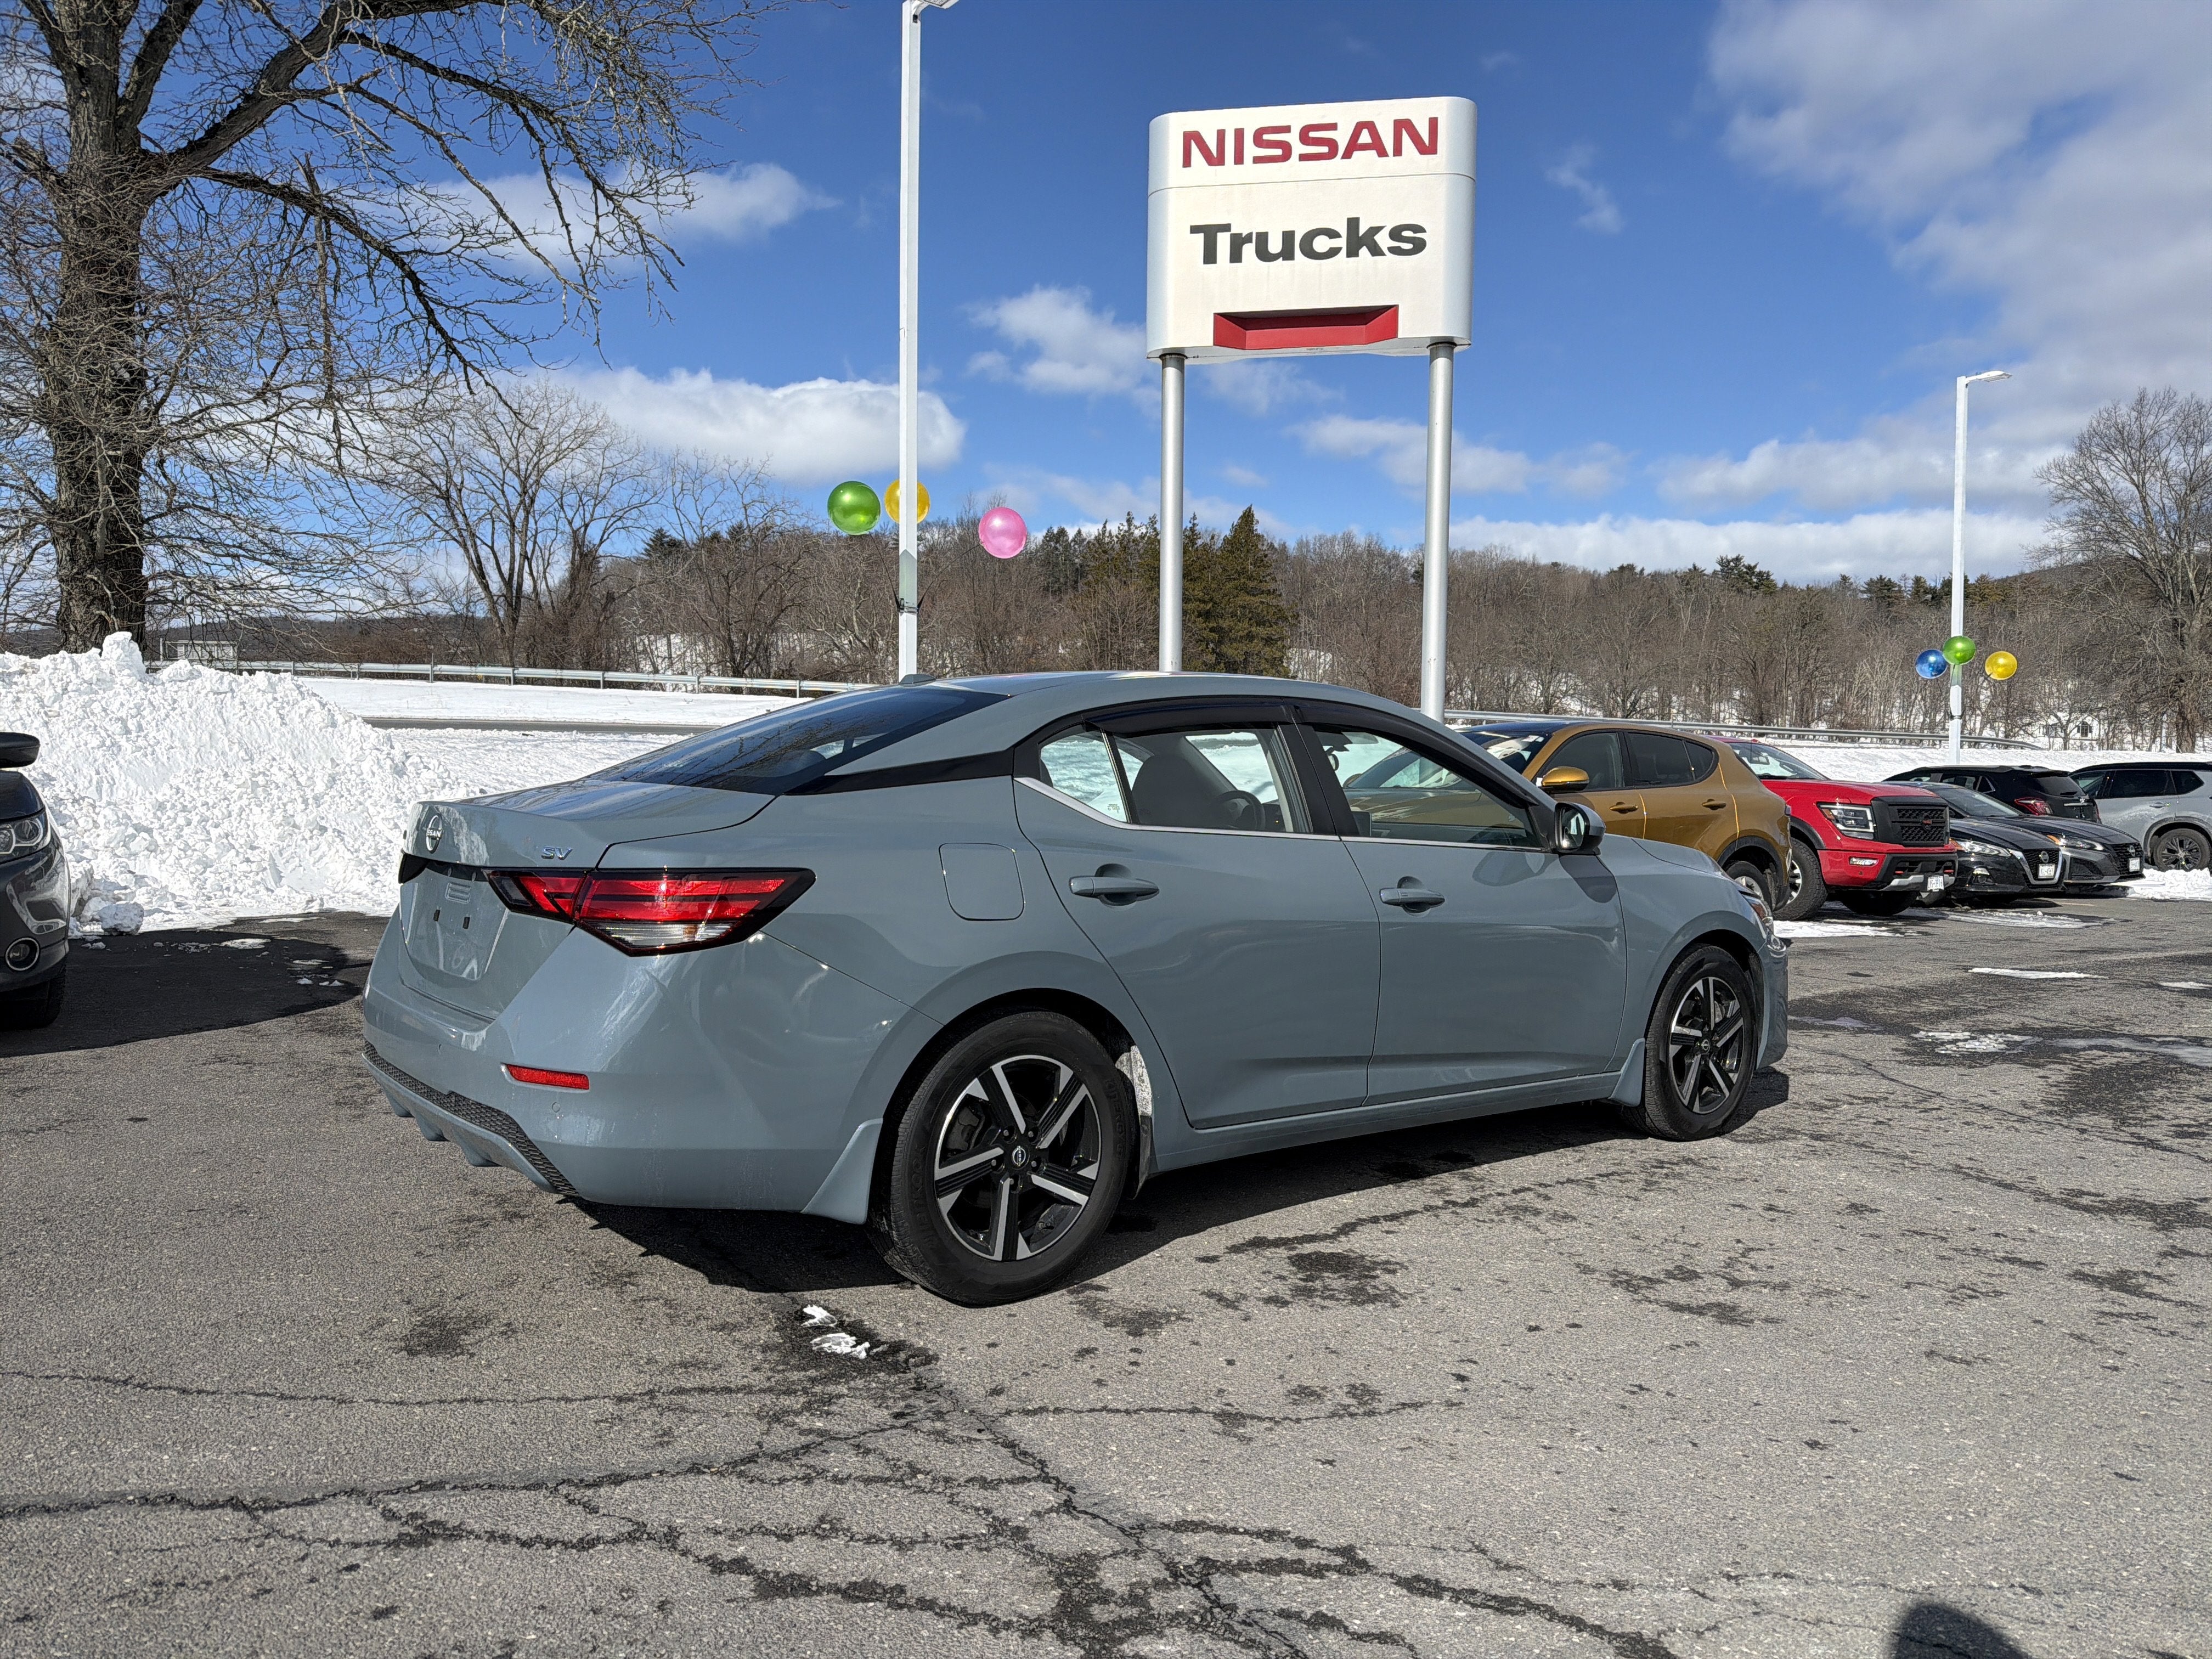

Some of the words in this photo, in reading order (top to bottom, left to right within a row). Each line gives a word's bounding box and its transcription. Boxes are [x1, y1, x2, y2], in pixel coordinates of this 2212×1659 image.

[1182, 116, 1438, 168] NISSAN
[1189, 217, 1427, 264] Trucks
[541, 846, 573, 860] SV
